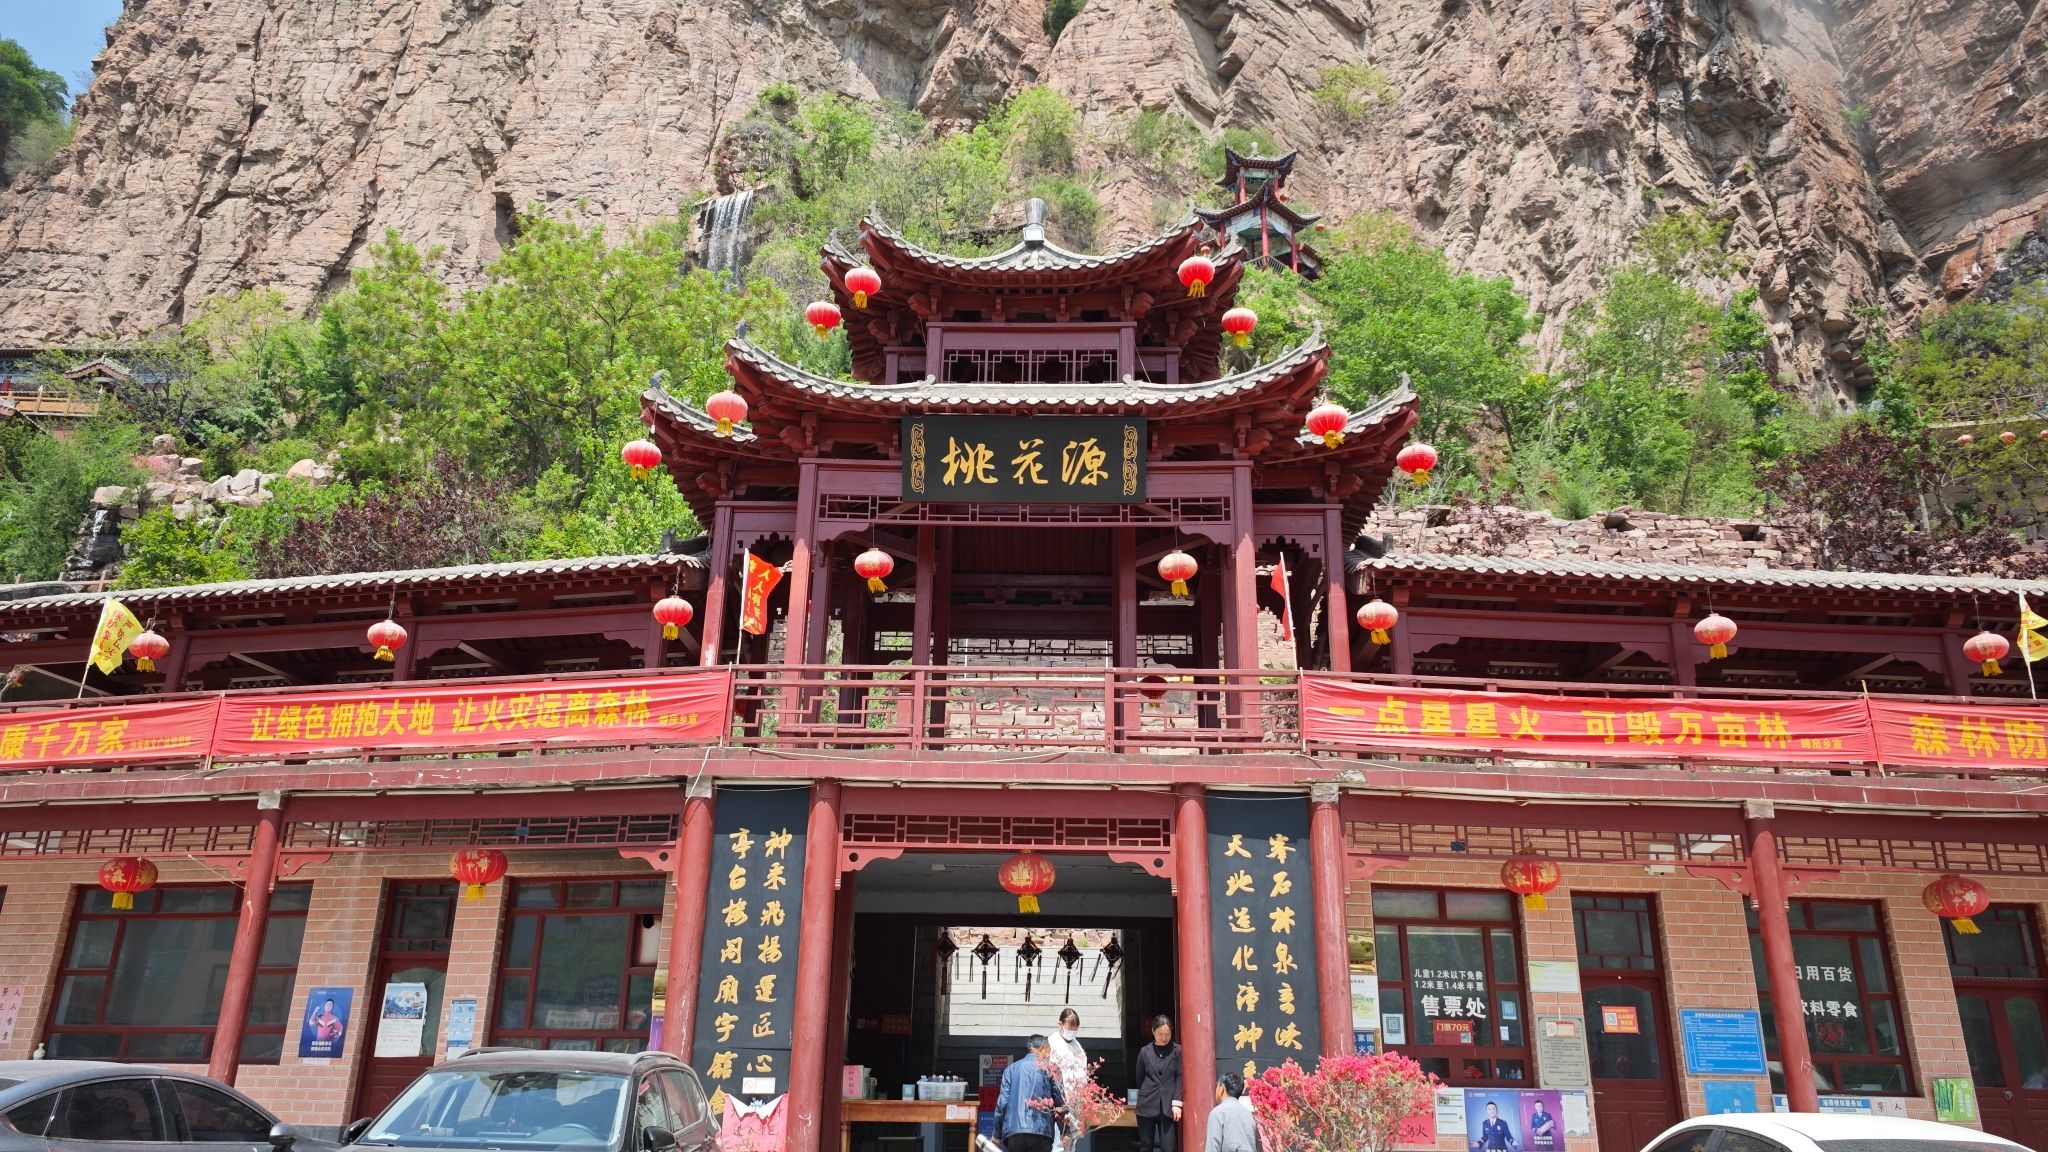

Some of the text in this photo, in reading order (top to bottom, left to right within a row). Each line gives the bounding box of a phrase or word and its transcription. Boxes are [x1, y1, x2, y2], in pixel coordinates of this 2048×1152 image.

[940, 436, 1109, 486] 桃花源
[0, 716, 130, 761] 康千万家
[251, 689, 653, 742] 让绿色拥抱大地 让火灾远离森林
[1328, 696, 1793, 750] 一点星星火 可毁万亩林
[1421, 994, 1487, 1019] 售票处
[1436, 1023, 1470, 1032] 门票70元
